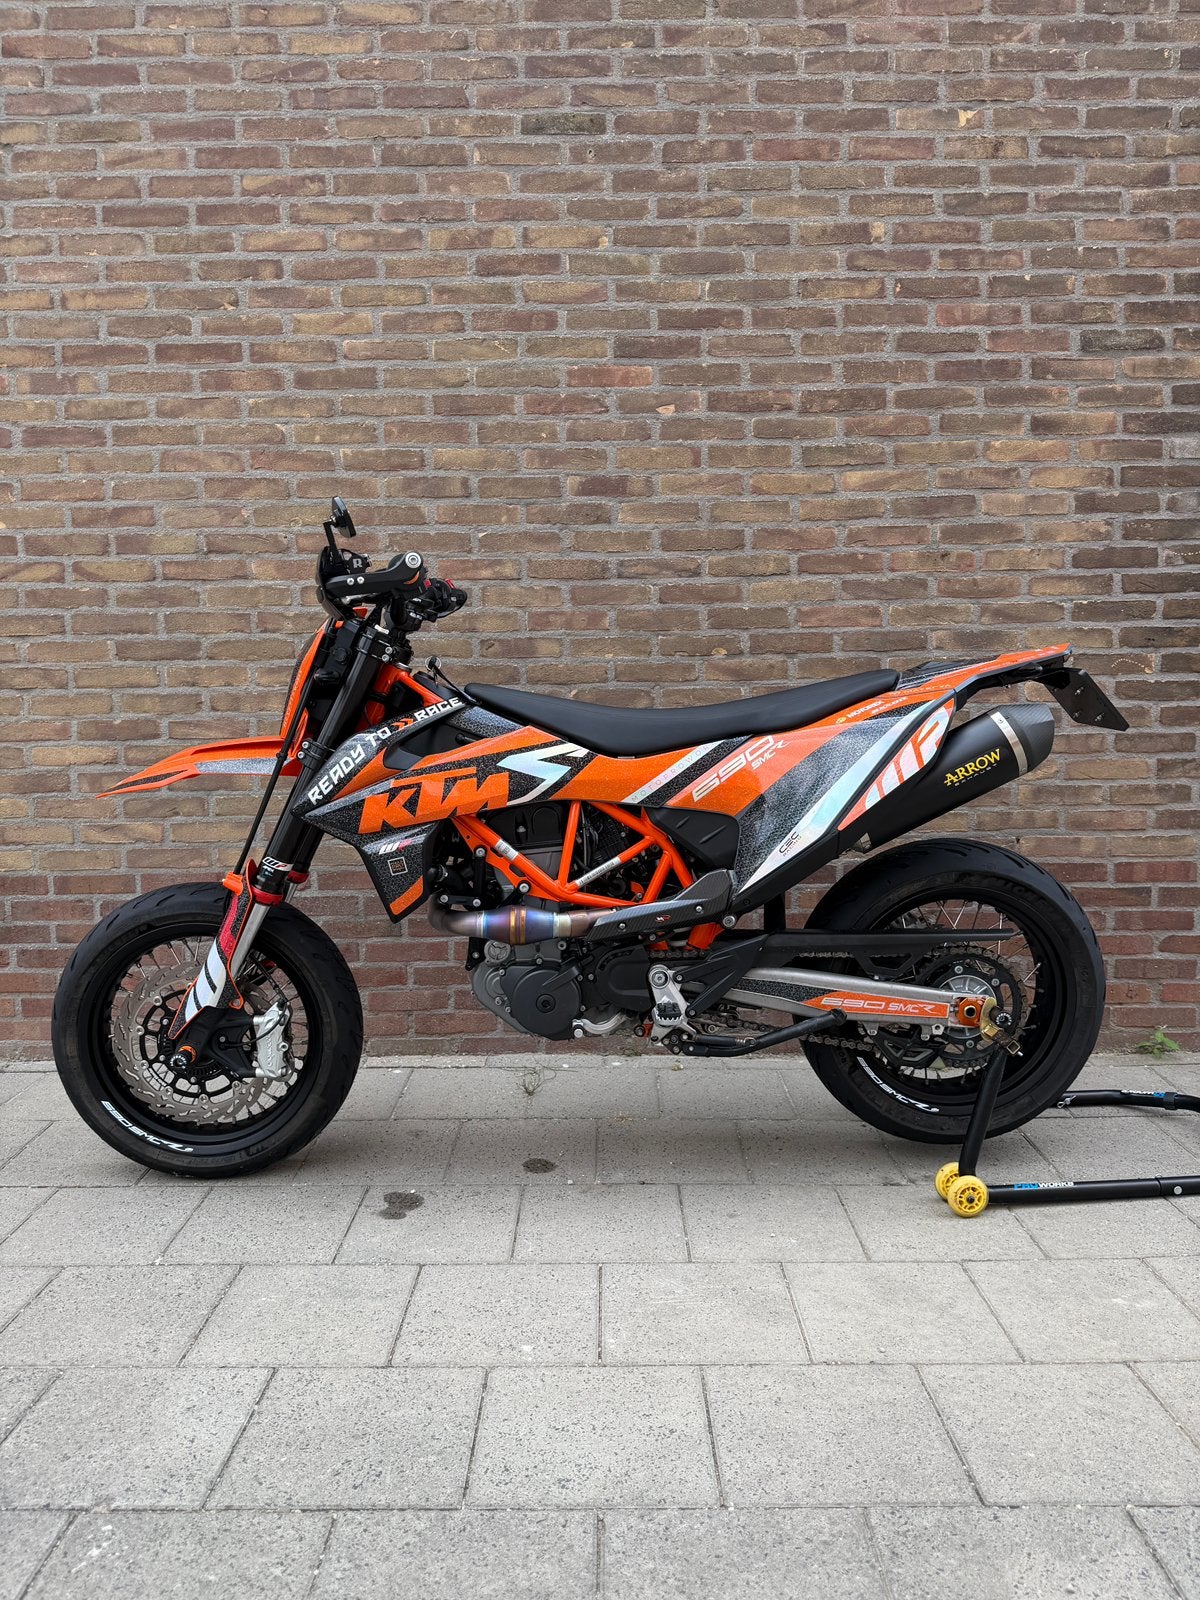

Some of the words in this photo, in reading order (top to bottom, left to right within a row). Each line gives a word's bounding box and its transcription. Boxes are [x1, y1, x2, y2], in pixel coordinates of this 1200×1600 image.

[308, 744, 366, 805] READY
[365, 727, 392, 747] TO
[414, 697, 464, 721] RACE
[691, 735, 775, 802] 690
[944, 748, 1000, 786] ARROW
[358, 767, 509, 834] KTM
[821, 997, 885, 1009] 690
